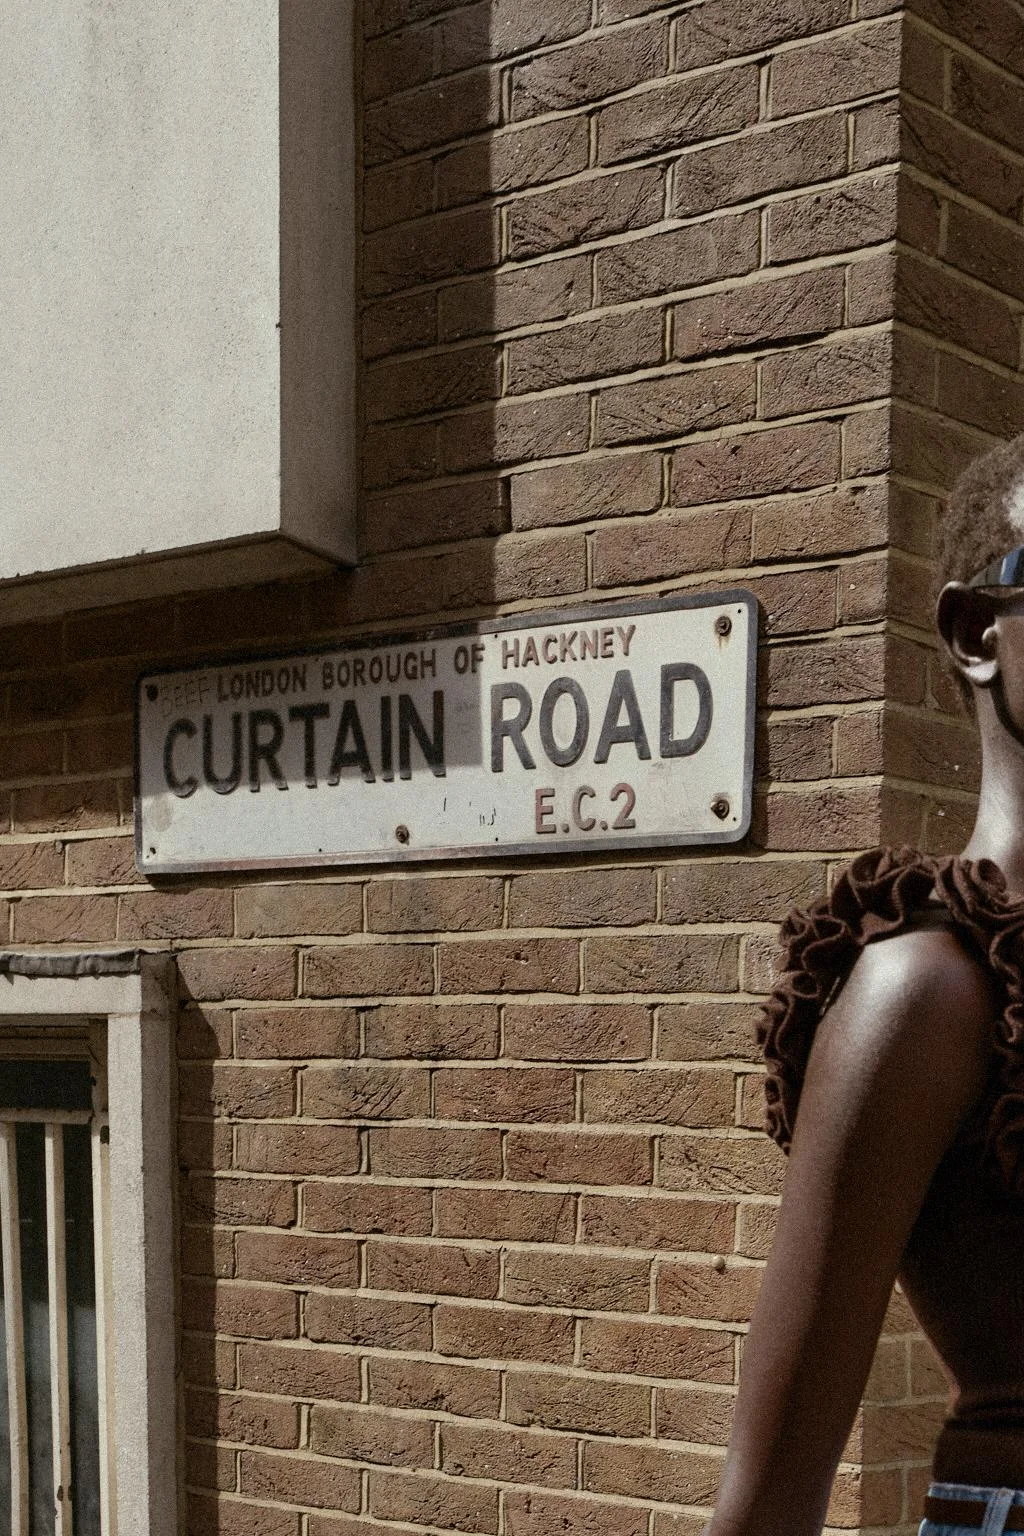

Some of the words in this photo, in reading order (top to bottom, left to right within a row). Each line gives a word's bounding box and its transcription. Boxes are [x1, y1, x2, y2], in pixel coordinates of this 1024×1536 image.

[217, 664, 307, 703] LONDON
[321, 648, 437, 690] BOROUGH
[453, 644, 486, 674] OF
[501, 625, 637, 669] HACKNEY
[164, 690, 446, 798] CURTAIN
[490, 663, 714, 773] ROAD
[535, 783, 636, 834] E.C.2
